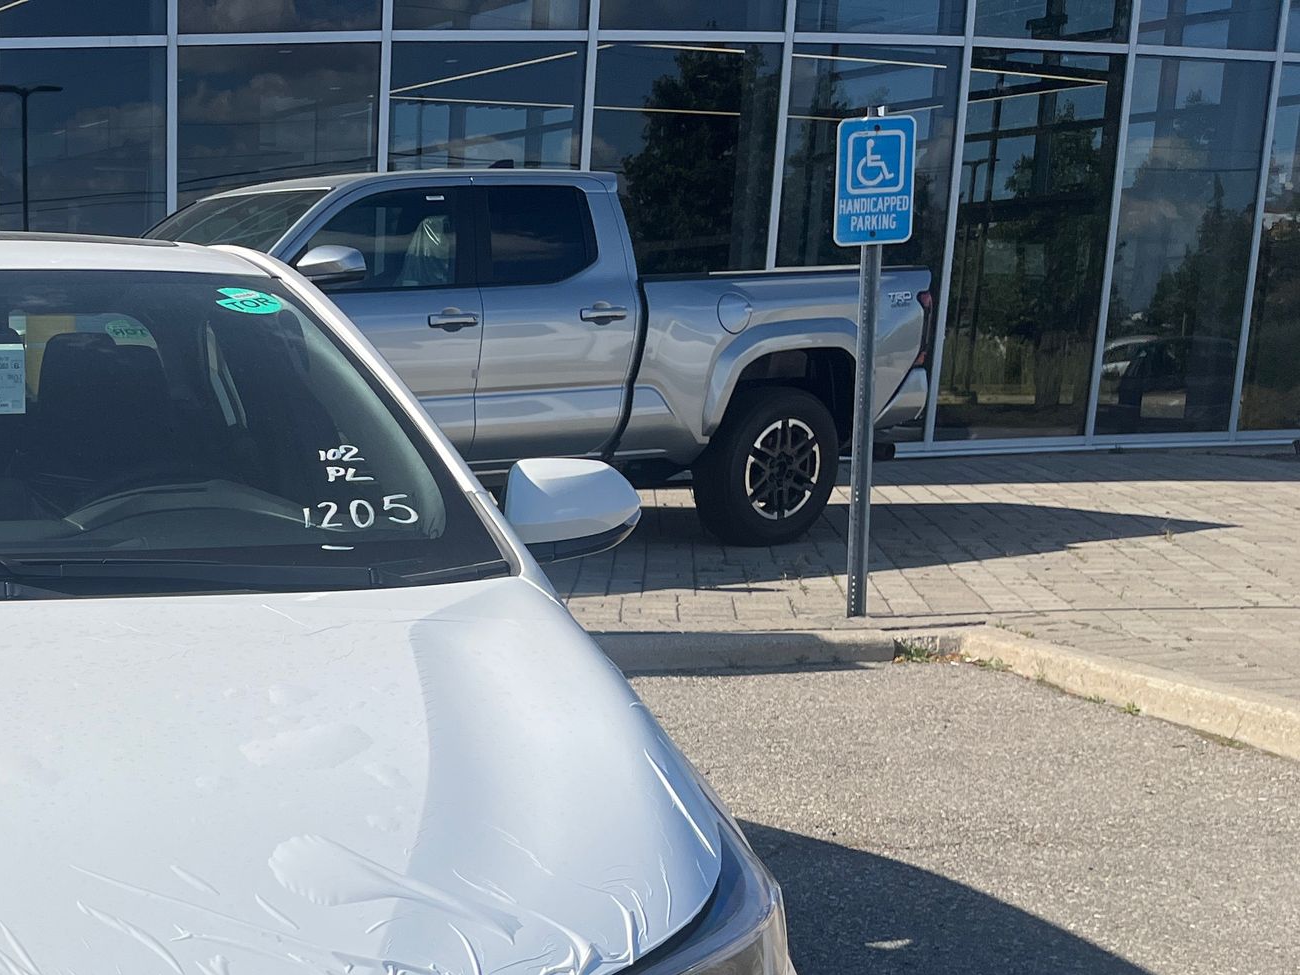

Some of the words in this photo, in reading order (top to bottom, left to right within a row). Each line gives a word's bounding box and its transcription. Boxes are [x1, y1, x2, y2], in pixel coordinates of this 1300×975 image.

[840, 195, 909, 214] HANDICAPPED
[850, 214, 897, 232] PARKING
[225, 297, 277, 310] TOR
[318, 444, 365, 461] 102
[302, 493, 420, 529] 1205
